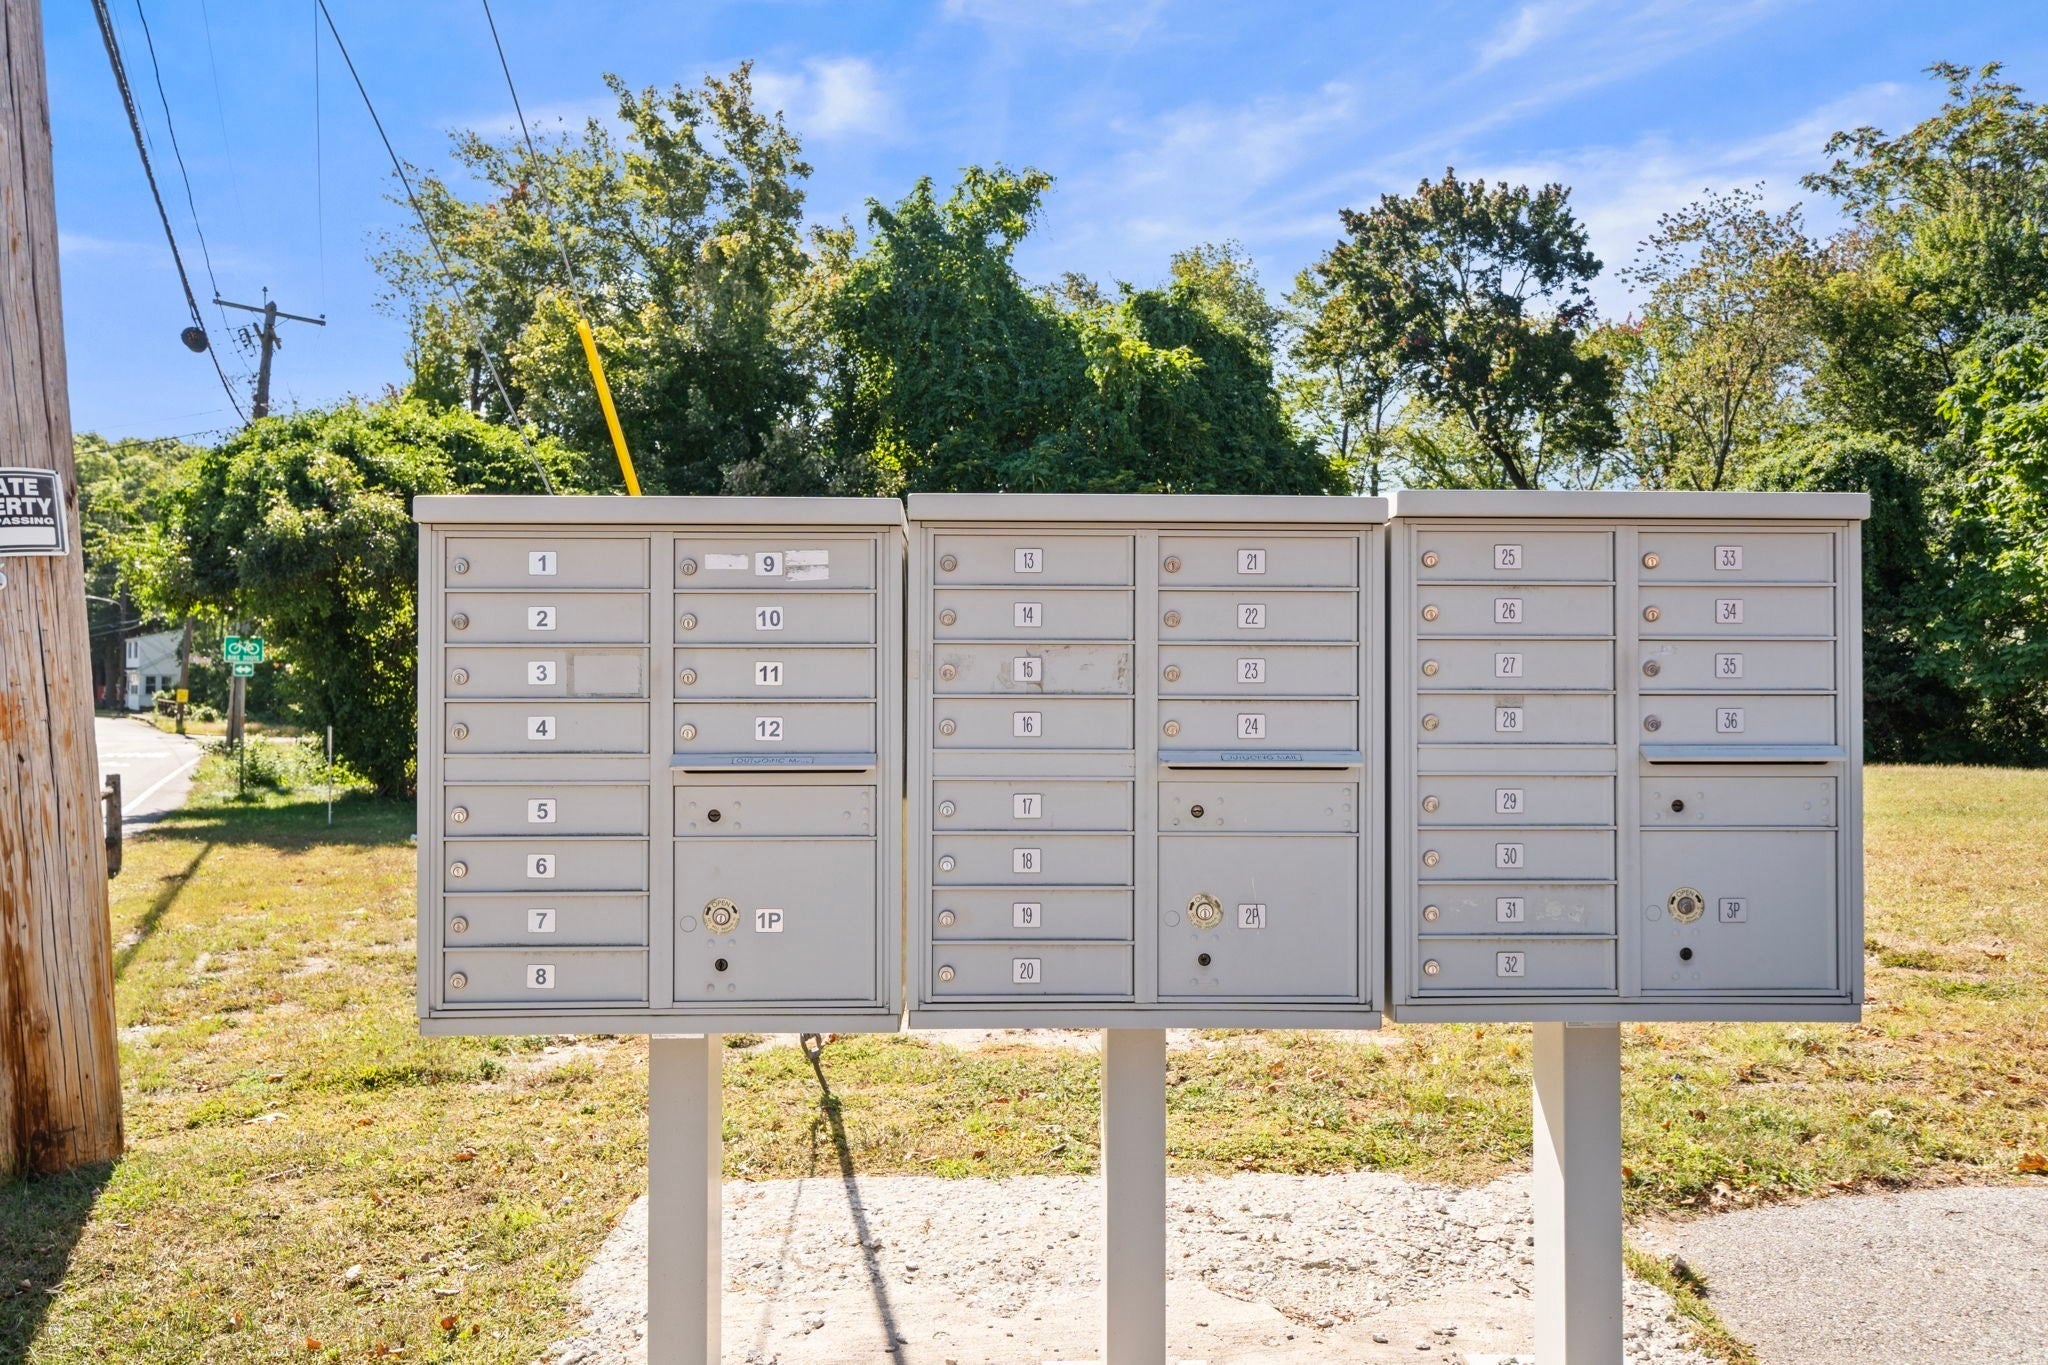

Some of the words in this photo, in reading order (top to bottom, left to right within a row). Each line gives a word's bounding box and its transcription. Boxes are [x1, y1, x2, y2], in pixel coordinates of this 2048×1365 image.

[537, 554, 547, 572] 1
[763, 555, 775, 573] 9
[1023, 552, 1035, 569] 13
[1246, 553, 1257, 571] 21
[1501, 548, 1516, 566] 25
[1722, 549, 1736, 567] 33
[536, 610, 548, 627] 2
[757, 609, 781, 627] 10
[1022, 606, 1034, 624] 14
[1244, 607, 1259, 625] 22
[1502, 602, 1516, 620] 26
[1722, 602, 1737, 620] 34
[536, 664, 548, 682] 3
[759, 665, 779, 682] 11
[1022, 660, 1034, 679] 15
[1244, 662, 1259, 680] 23
[1502, 656, 1516, 674] 27
[1722, 657, 1737, 675] 35
[535, 719, 549, 737] 4
[1022, 715, 1033, 733] 16
[1244, 717, 1259, 735] 24
[1502, 710, 1517, 729] 28
[1723, 712, 1738, 729] 36
[757, 720, 781, 738] 12
[1022, 797, 1033, 815] 17
[1503, 792, 1517, 810] 29
[536, 802, 549, 820] 5
[1022, 852, 1033, 870] 18
[1503, 847, 1518, 865] 30
[535, 857, 548, 875] 6
[1676, 889, 1695, 898] OPEN
[711, 899, 731, 908] OPEN
[1505, 901, 1516, 919] 31
[1726, 901, 1741, 919] 3P
[535, 912, 548, 929] 7
[757, 912, 782, 929] 1P
[1022, 906, 1033, 925] 19
[1245, 907, 1260, 925] 2P
[1019, 962, 1034, 980] 20
[1504, 955, 1518, 973] 32
[535, 967, 547, 986] 8
